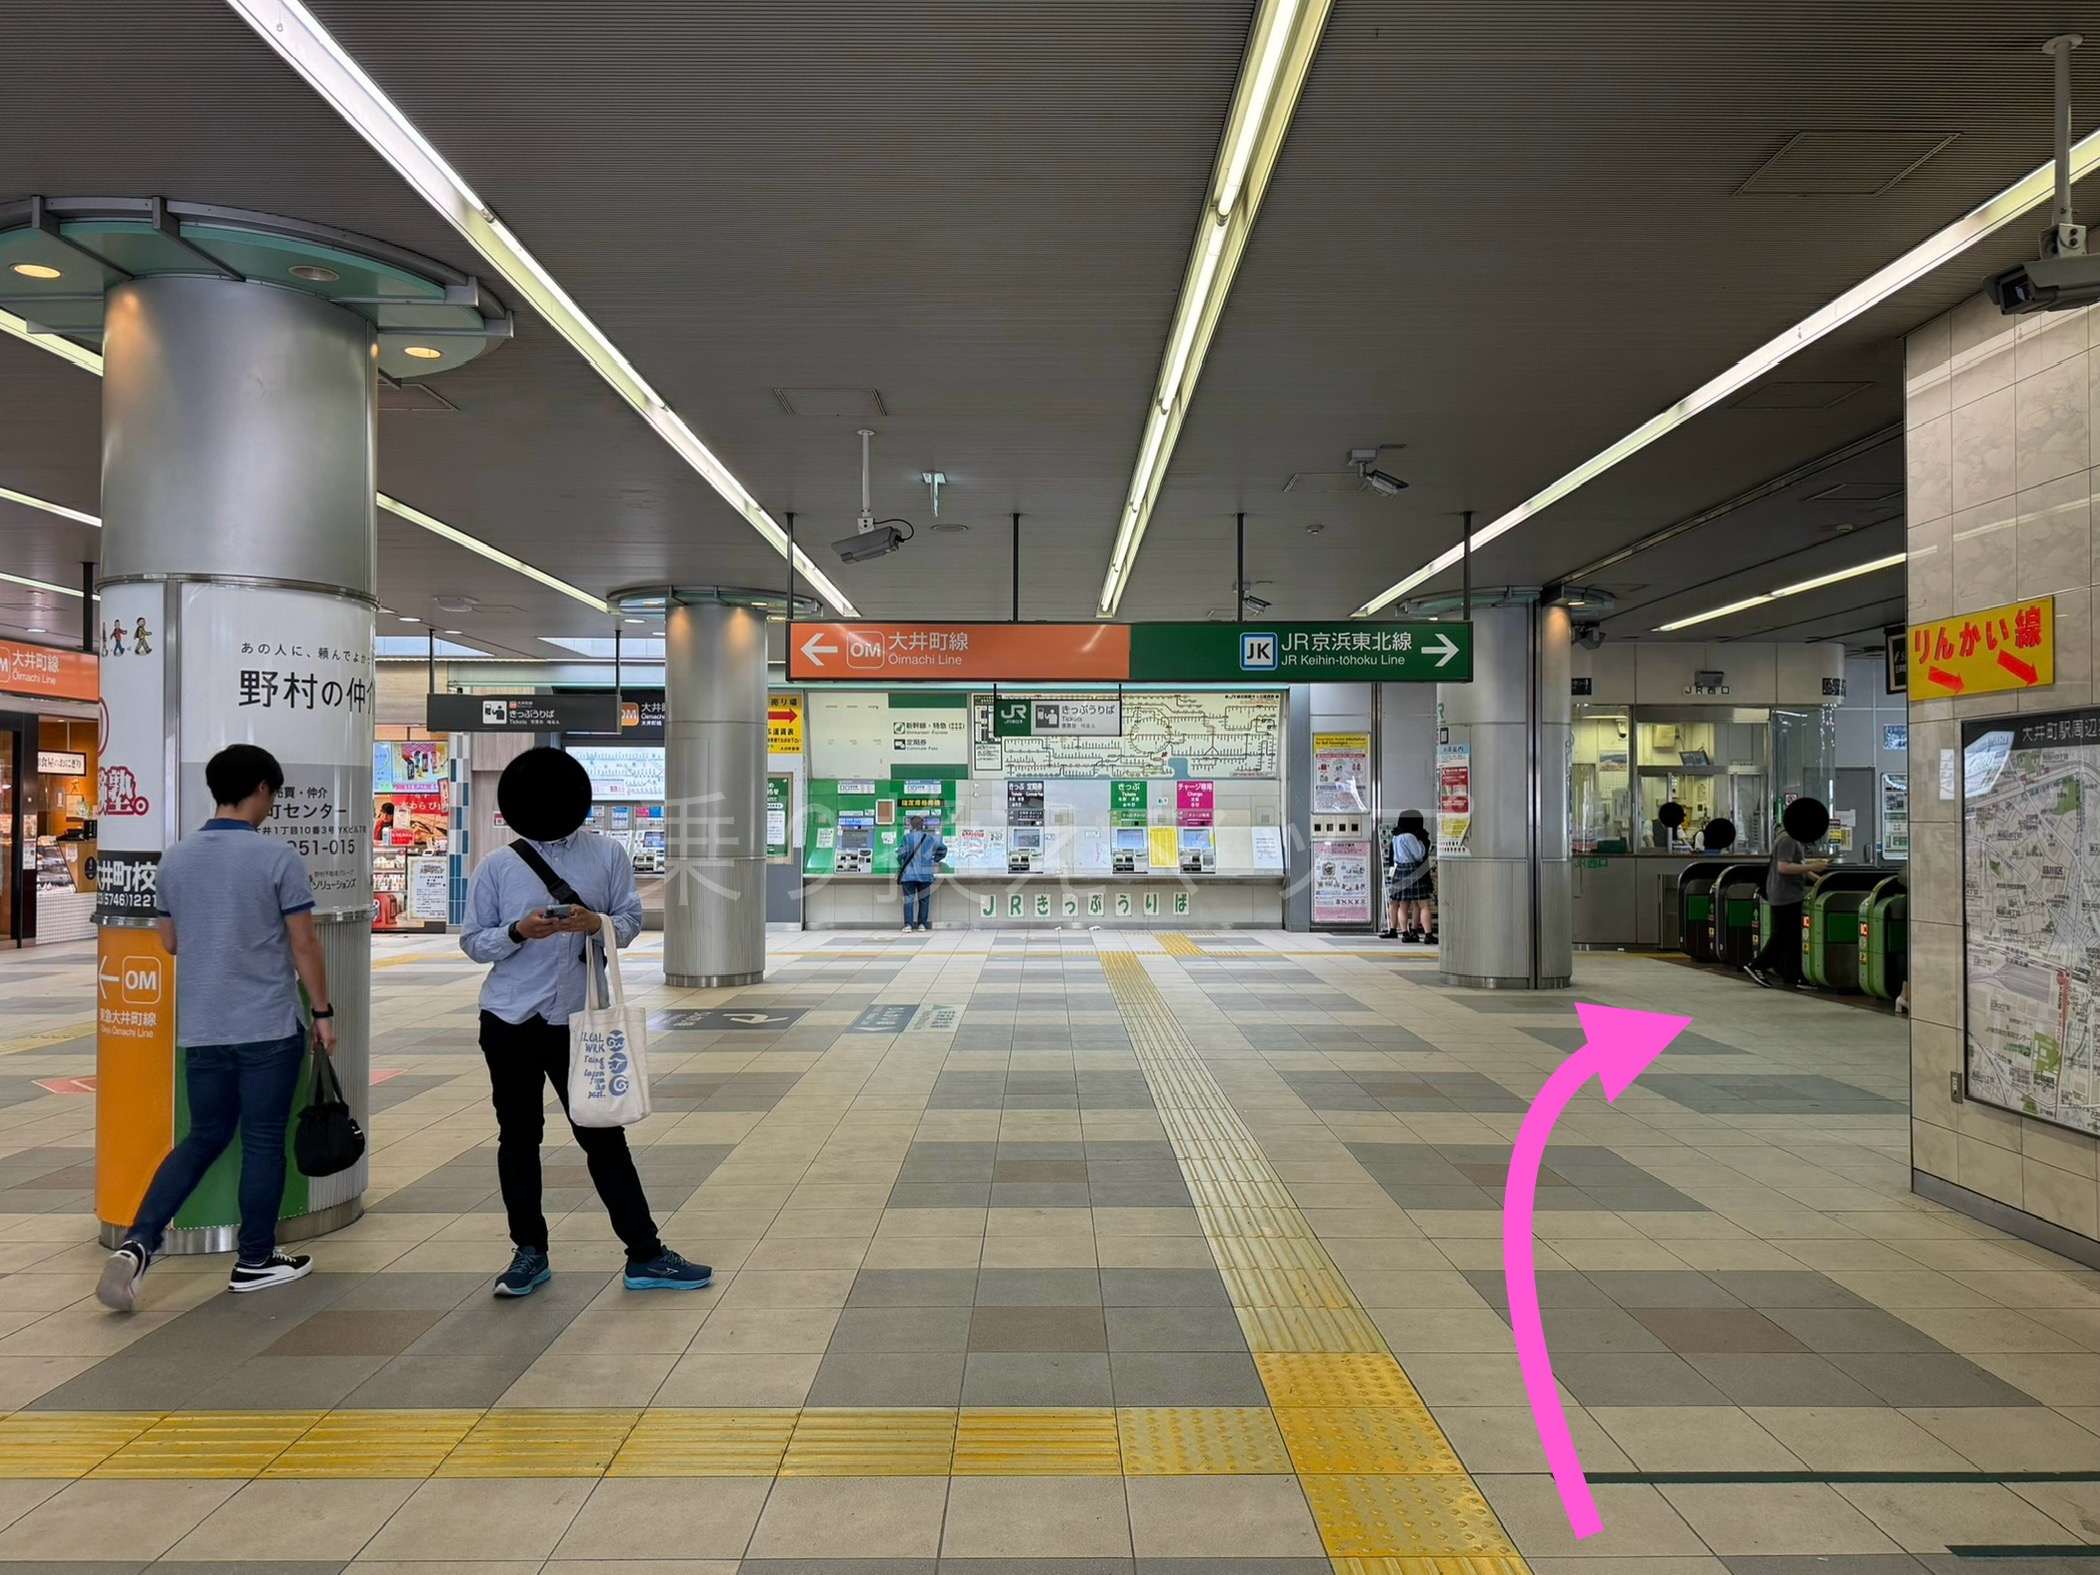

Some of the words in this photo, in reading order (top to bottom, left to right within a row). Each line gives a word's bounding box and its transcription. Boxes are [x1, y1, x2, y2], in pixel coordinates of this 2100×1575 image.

[888, 632, 969, 650] 大井町線
[1282, 632, 1412, 651] JR京浜東北線
[1914, 605, 2042, 665] りんかい線
[850, 643, 881, 658] OM
[1247, 643, 1271, 660] JK
[0, 658, 8, 673] M
[12, 650, 59, 673] 大井町線
[938, 654, 962, 665] Line
[1282, 655, 1298, 665] JR
[1381, 654, 1405, 666] Line
[1684, 686, 1730, 695] JR西口
[509, 709, 555, 719] きっぷうりば
[1000, 704, 1027, 719] JR
[1061, 704, 1116, 714] きっぷうりば
[2022, 718, 2100, 742] 大井町駅周辺
[38, 756, 81, 770] 食屋のおにぎり
[1118, 783, 1140, 791] きっぷ
[1178, 783, 1212, 791] チャージ専用
[258, 826, 335, 835] 井1丁目10番3号
[983, 894, 1187, 916] JRきっぷうりば
[125, 970, 157, 990] OM
[137, 1027, 153, 1038] Line
